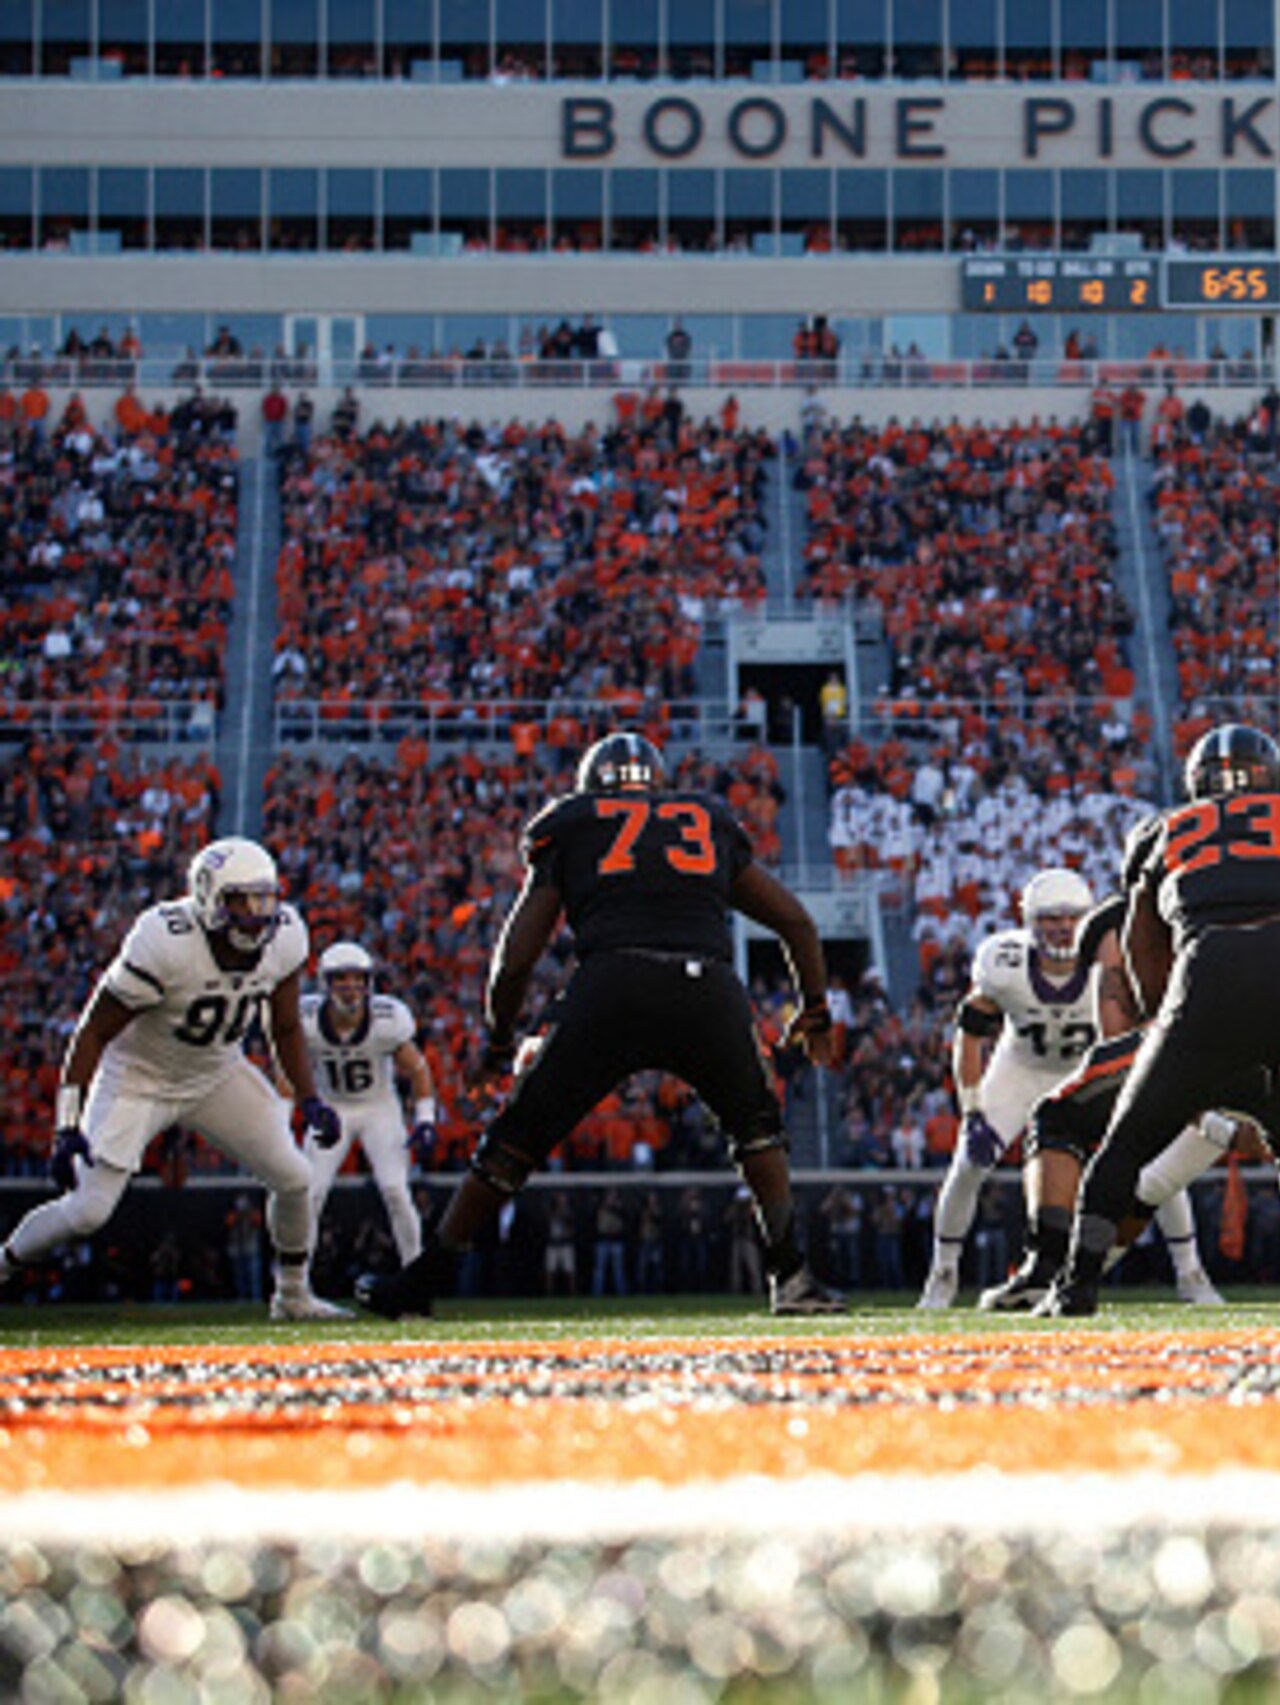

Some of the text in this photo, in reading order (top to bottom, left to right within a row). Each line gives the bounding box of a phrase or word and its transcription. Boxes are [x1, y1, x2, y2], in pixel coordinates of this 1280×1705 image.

[559, 96, 946, 160] BOONE
[1129, 278, 1148, 305] 2
[1202, 266, 1268, 300] 6:55
[596, 798, 716, 874] 73
[321, 1059, 375, 1094] 16
